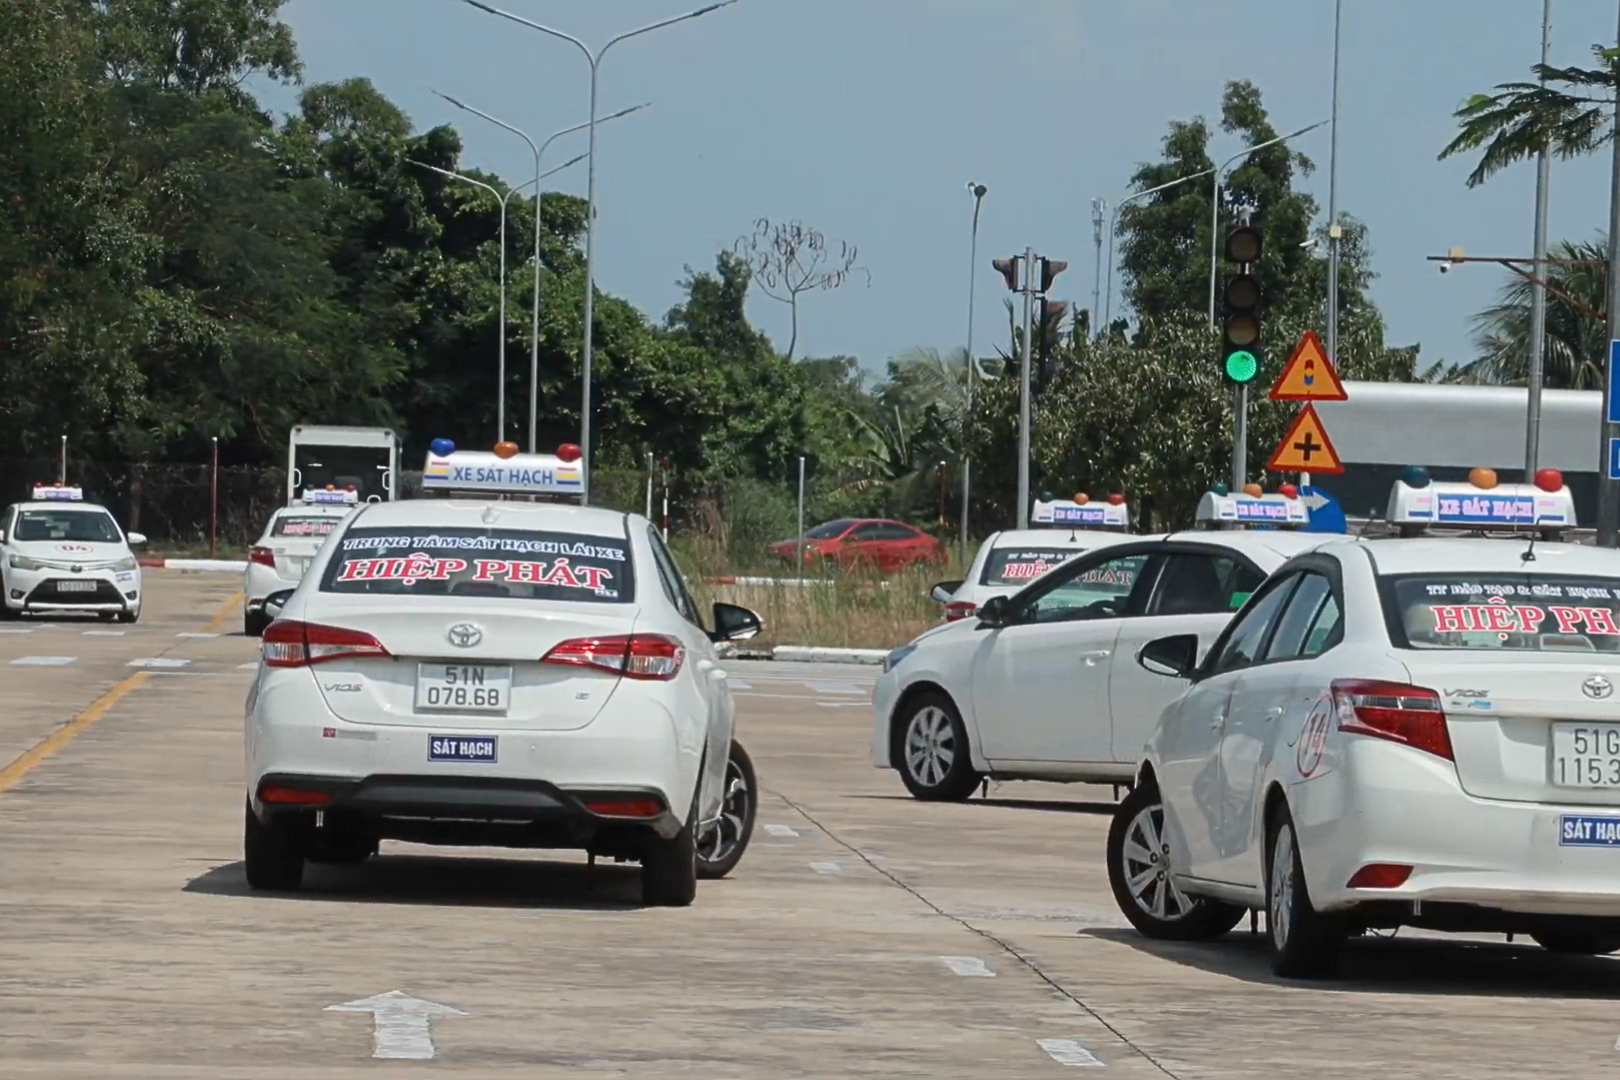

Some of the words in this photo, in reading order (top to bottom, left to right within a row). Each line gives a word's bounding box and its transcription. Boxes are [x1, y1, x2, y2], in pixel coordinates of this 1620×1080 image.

[454, 467, 472, 481] XE
[509, 468, 553, 486] HẠCH
[1440, 499, 1460, 515] XE
[343, 536, 411, 550] TRUNG
[500, 539, 558, 553] HẠCH
[595, 546, 626, 561] XE
[337, 551, 467, 586] HIỆP
[472, 557, 613, 589] PHÁT
[1429, 596, 1545, 640] HIỆP
[1548, 606, 1620, 635] PH
[445, 667, 485, 685] 51N
[324, 683, 363, 692] VIOS
[428, 687, 499, 706] 078.68
[433, 738, 457, 755] SÁT
[459, 742, 493, 758] HẠCH
[1574, 728, 1620, 755] 51G
[1564, 818, 1592, 840] SÁT
